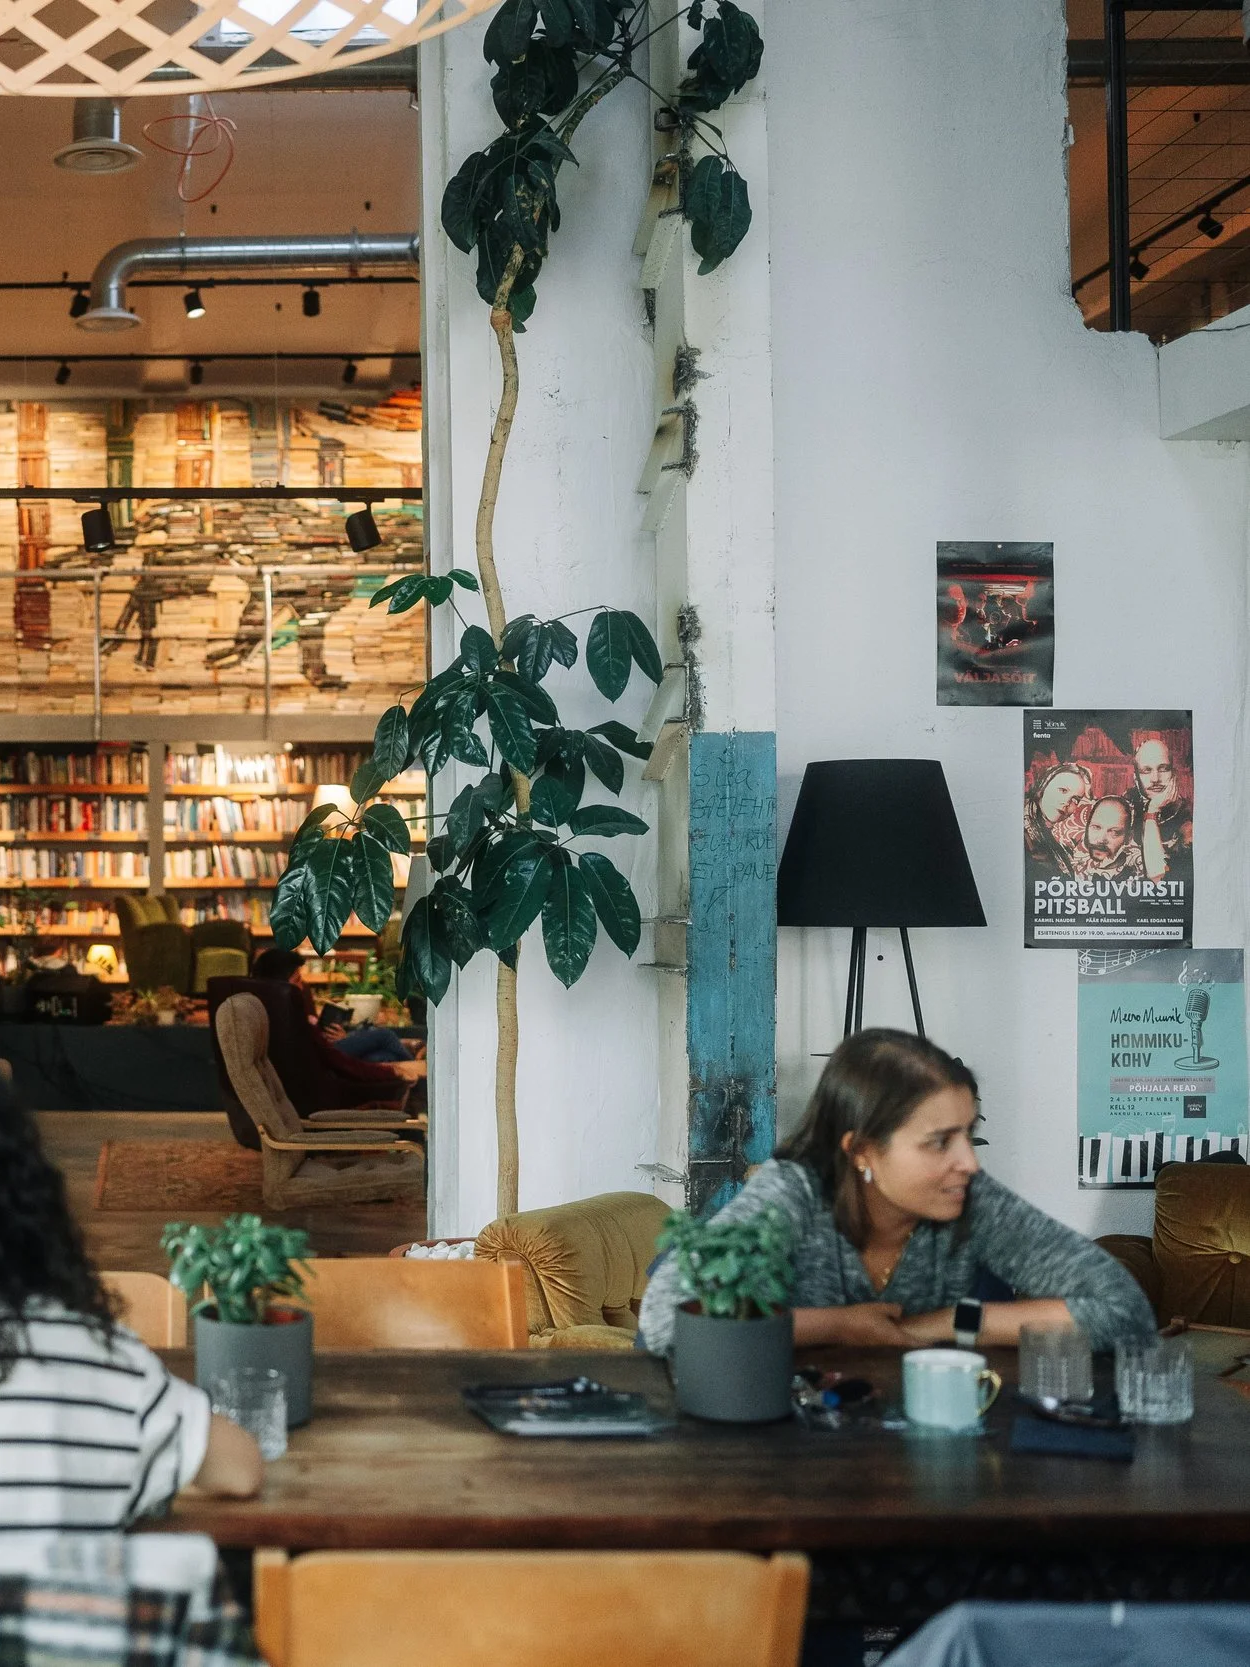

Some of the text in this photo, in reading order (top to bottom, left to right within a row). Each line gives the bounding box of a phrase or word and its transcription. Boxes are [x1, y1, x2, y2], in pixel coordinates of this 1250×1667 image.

[954, 670, 1037, 683] VÄLJASÕIT
[1034, 876, 1185, 897] PÕRGUVÜRSTI
[1034, 898, 1126, 915] PITSBALL
[1111, 1033, 1188, 1049] HOMMIKU-
[1111, 1052, 1152, 1068] KOHV
[1129, 1083, 1197, 1093] PÕHJALA READ
